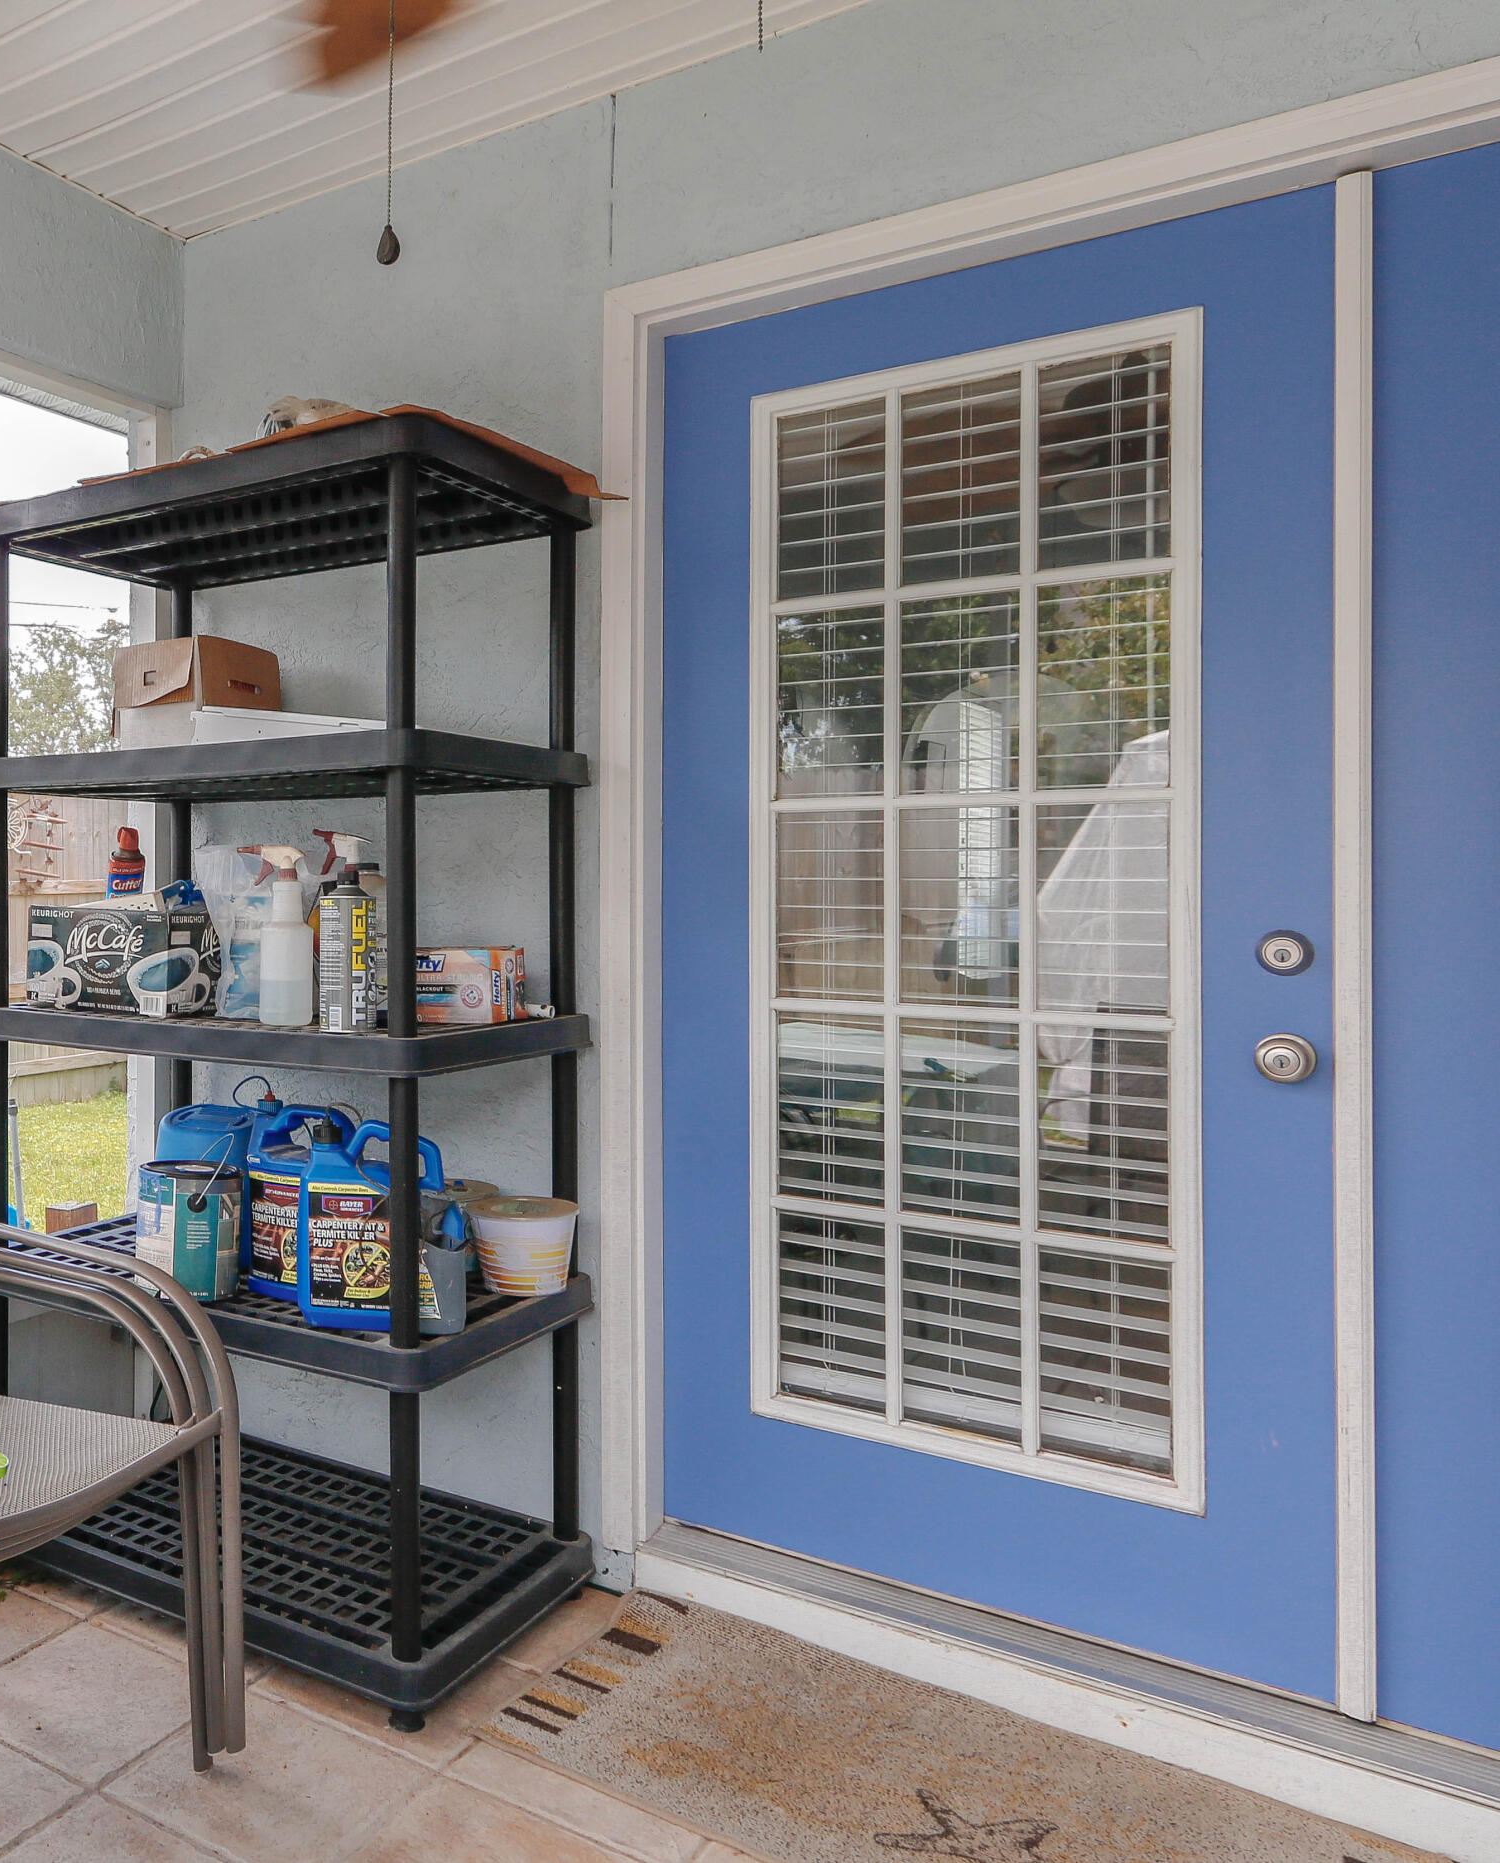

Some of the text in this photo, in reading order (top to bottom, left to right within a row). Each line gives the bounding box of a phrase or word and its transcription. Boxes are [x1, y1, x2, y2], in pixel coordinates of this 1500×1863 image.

[112, 879, 142, 891] Cutter
[66, 923, 145, 963] McCafé
[351, 900, 367, 1026] TRUFUEL
[417, 958, 442, 972] fty
[251, 1202, 298, 1219] CARPENTER AN
[252, 1211, 276, 1225] TERMITE
[311, 1220, 358, 1231] CARPENTER
[377, 1222, 385, 1232] &
[312, 1230, 347, 1239] TERMITE
[313, 1238, 334, 1248] PLUS
